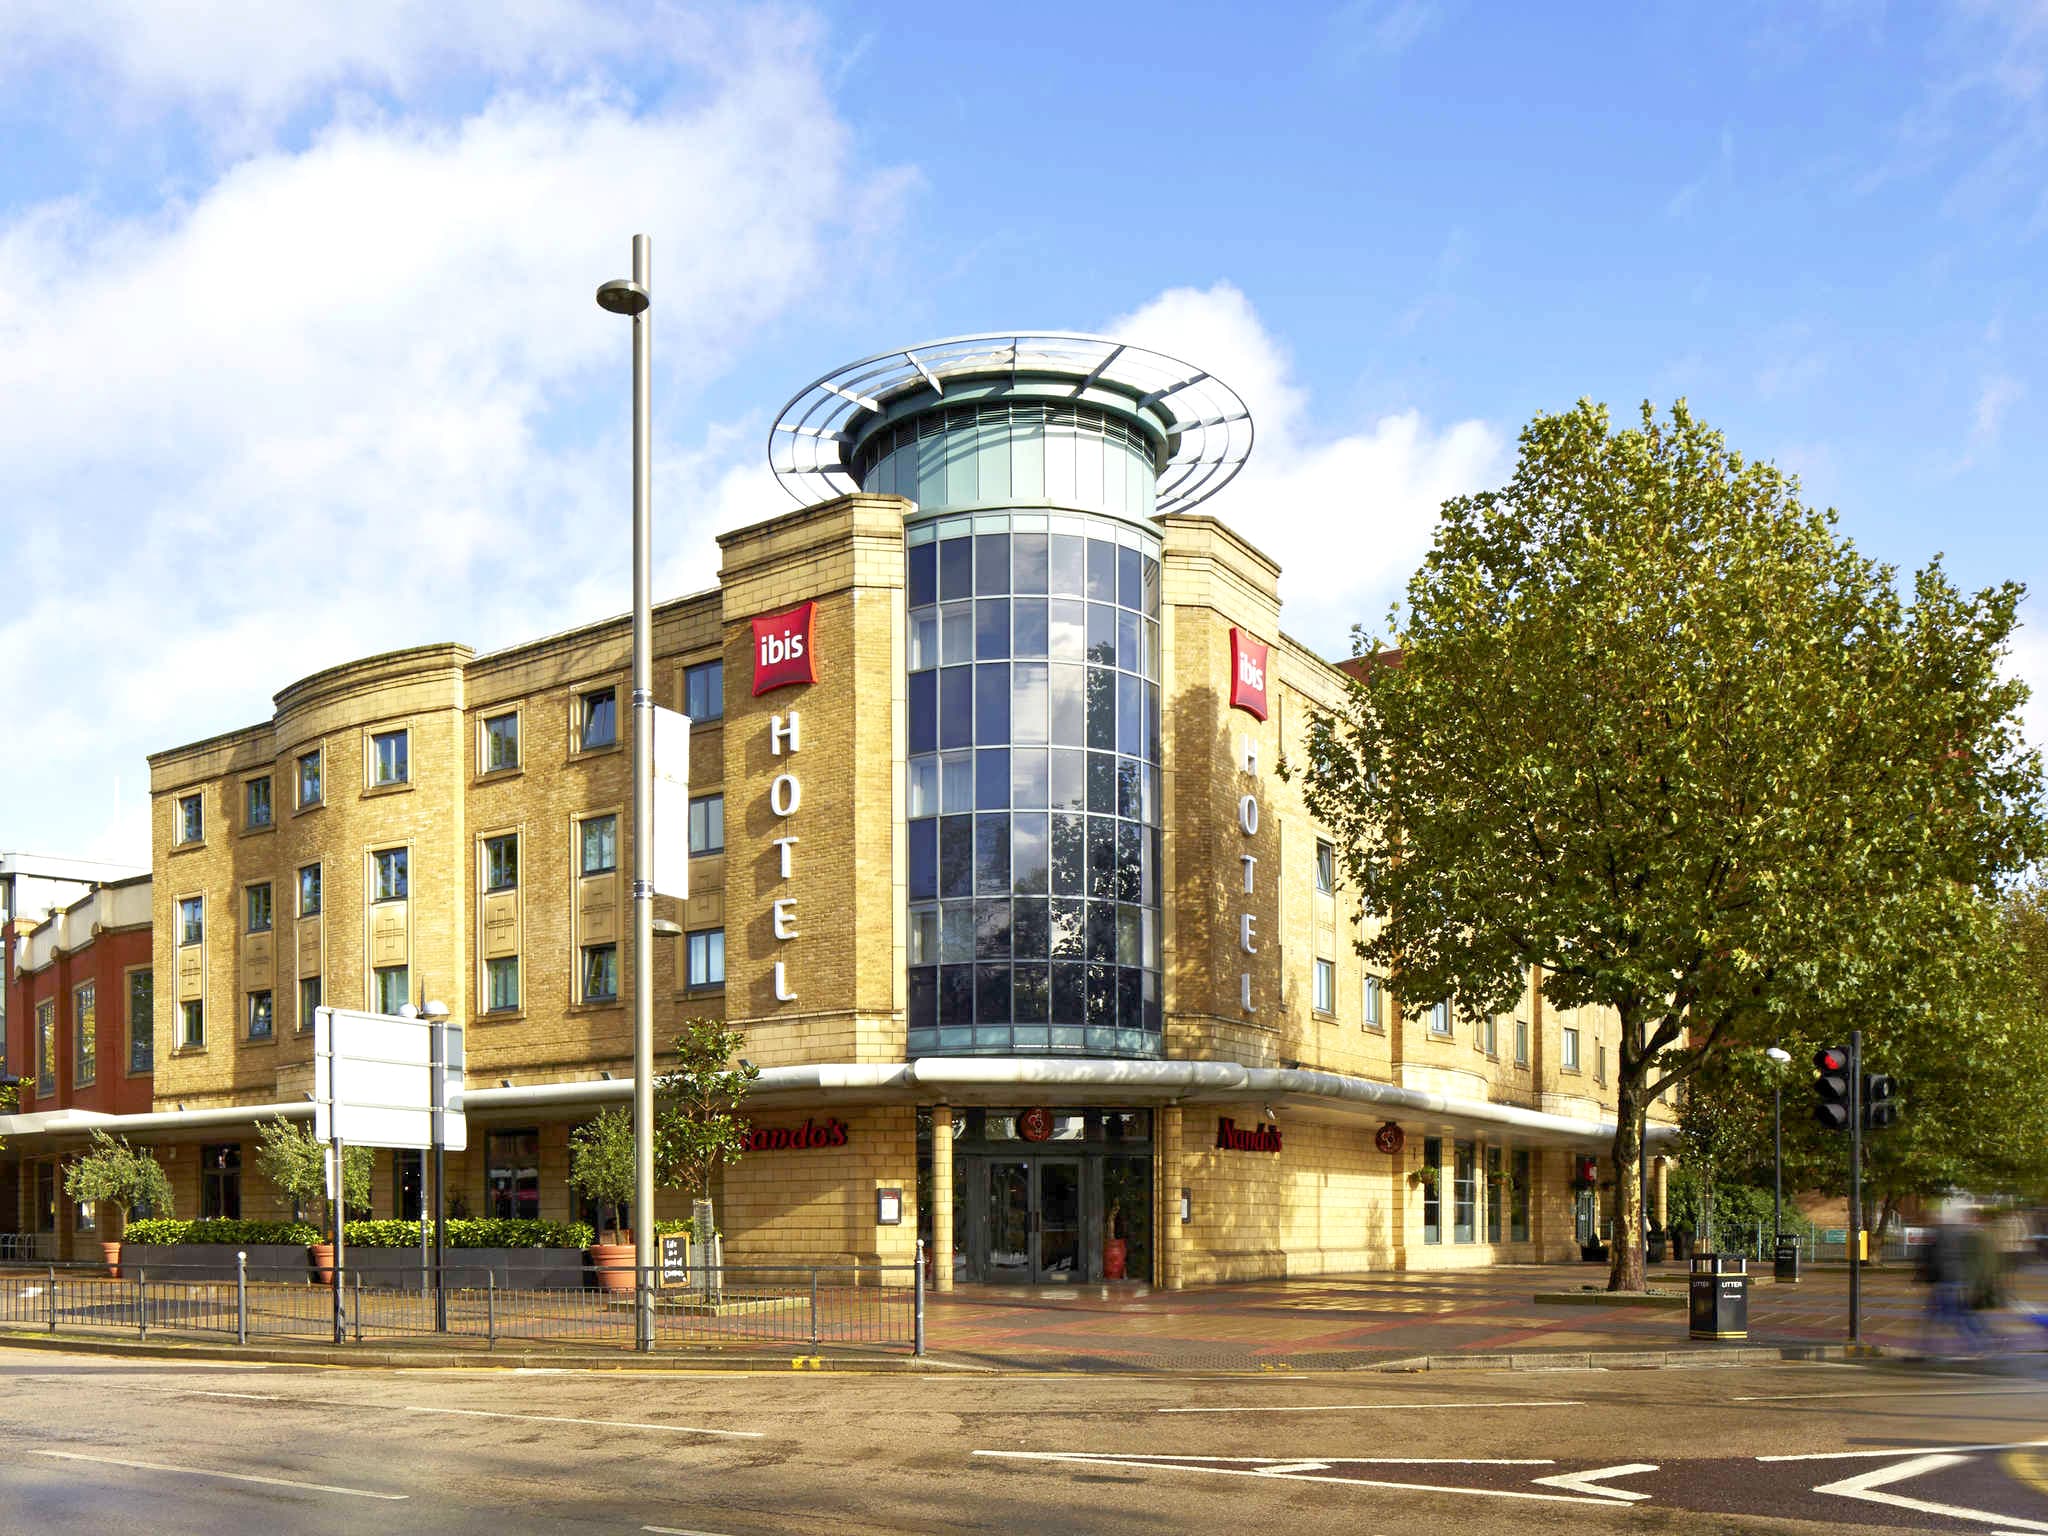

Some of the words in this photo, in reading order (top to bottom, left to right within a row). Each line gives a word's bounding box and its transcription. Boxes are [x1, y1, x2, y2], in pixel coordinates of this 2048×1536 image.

[761, 629, 804, 666] ibis
[1239, 652, 1264, 692] ibis
[770, 711, 800, 1001] HOTEL
[1239, 733, 1259, 1013] HOTEL
[739, 1117, 848, 1151] ando's
[1216, 1117, 1282, 1152] Nando's
